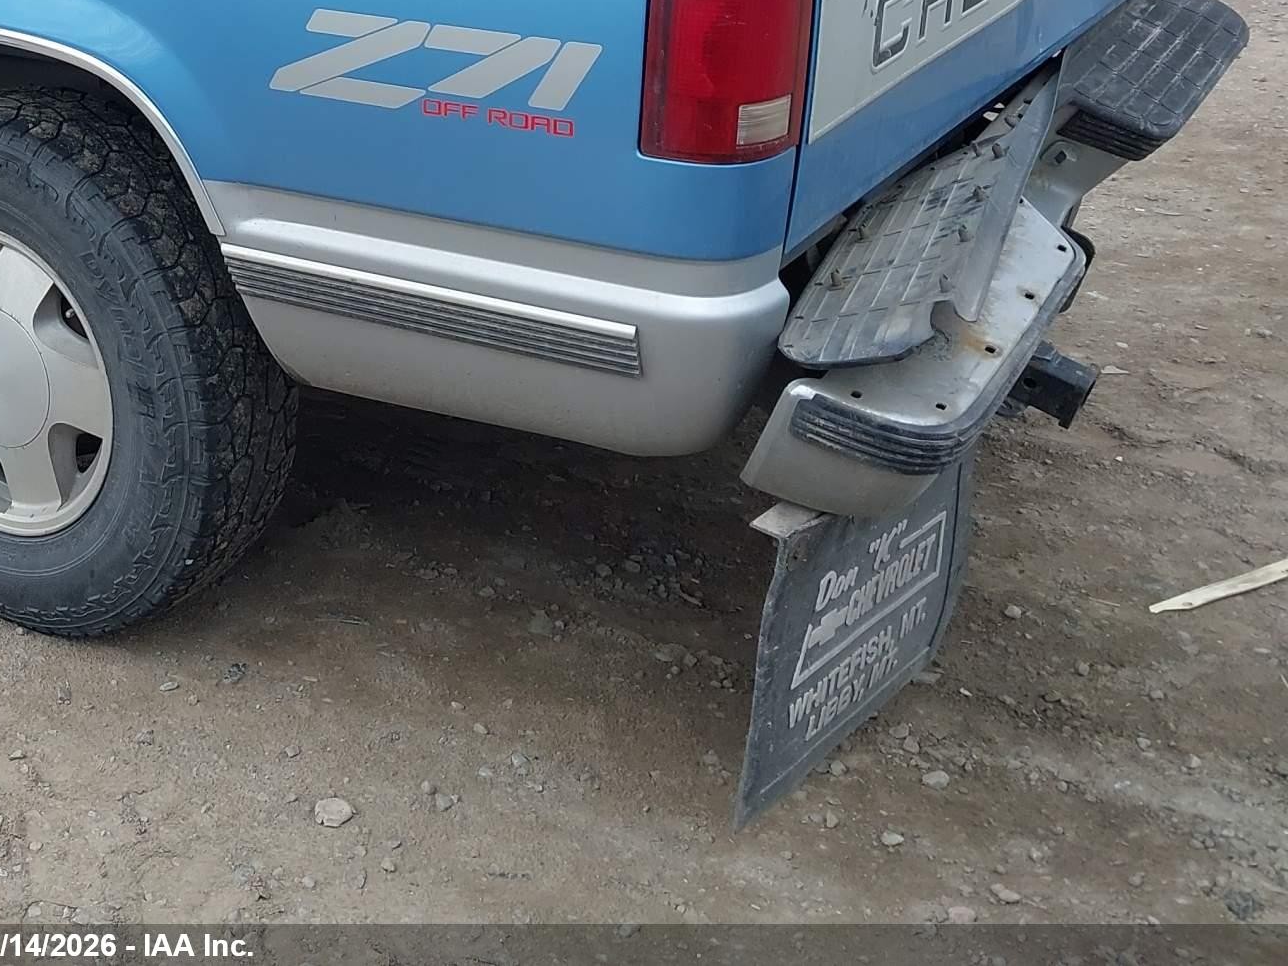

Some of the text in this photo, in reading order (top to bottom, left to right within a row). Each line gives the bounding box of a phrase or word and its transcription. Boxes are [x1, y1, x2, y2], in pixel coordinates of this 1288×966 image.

[269, 8, 603, 111] Z71
[421, 97, 575, 138] OFF ROAD
[845, 533, 937, 627] CHEVROLET
[789, 596, 927, 729] WHITEFISH, MT.
[805, 673, 865, 742] LIBBY,
